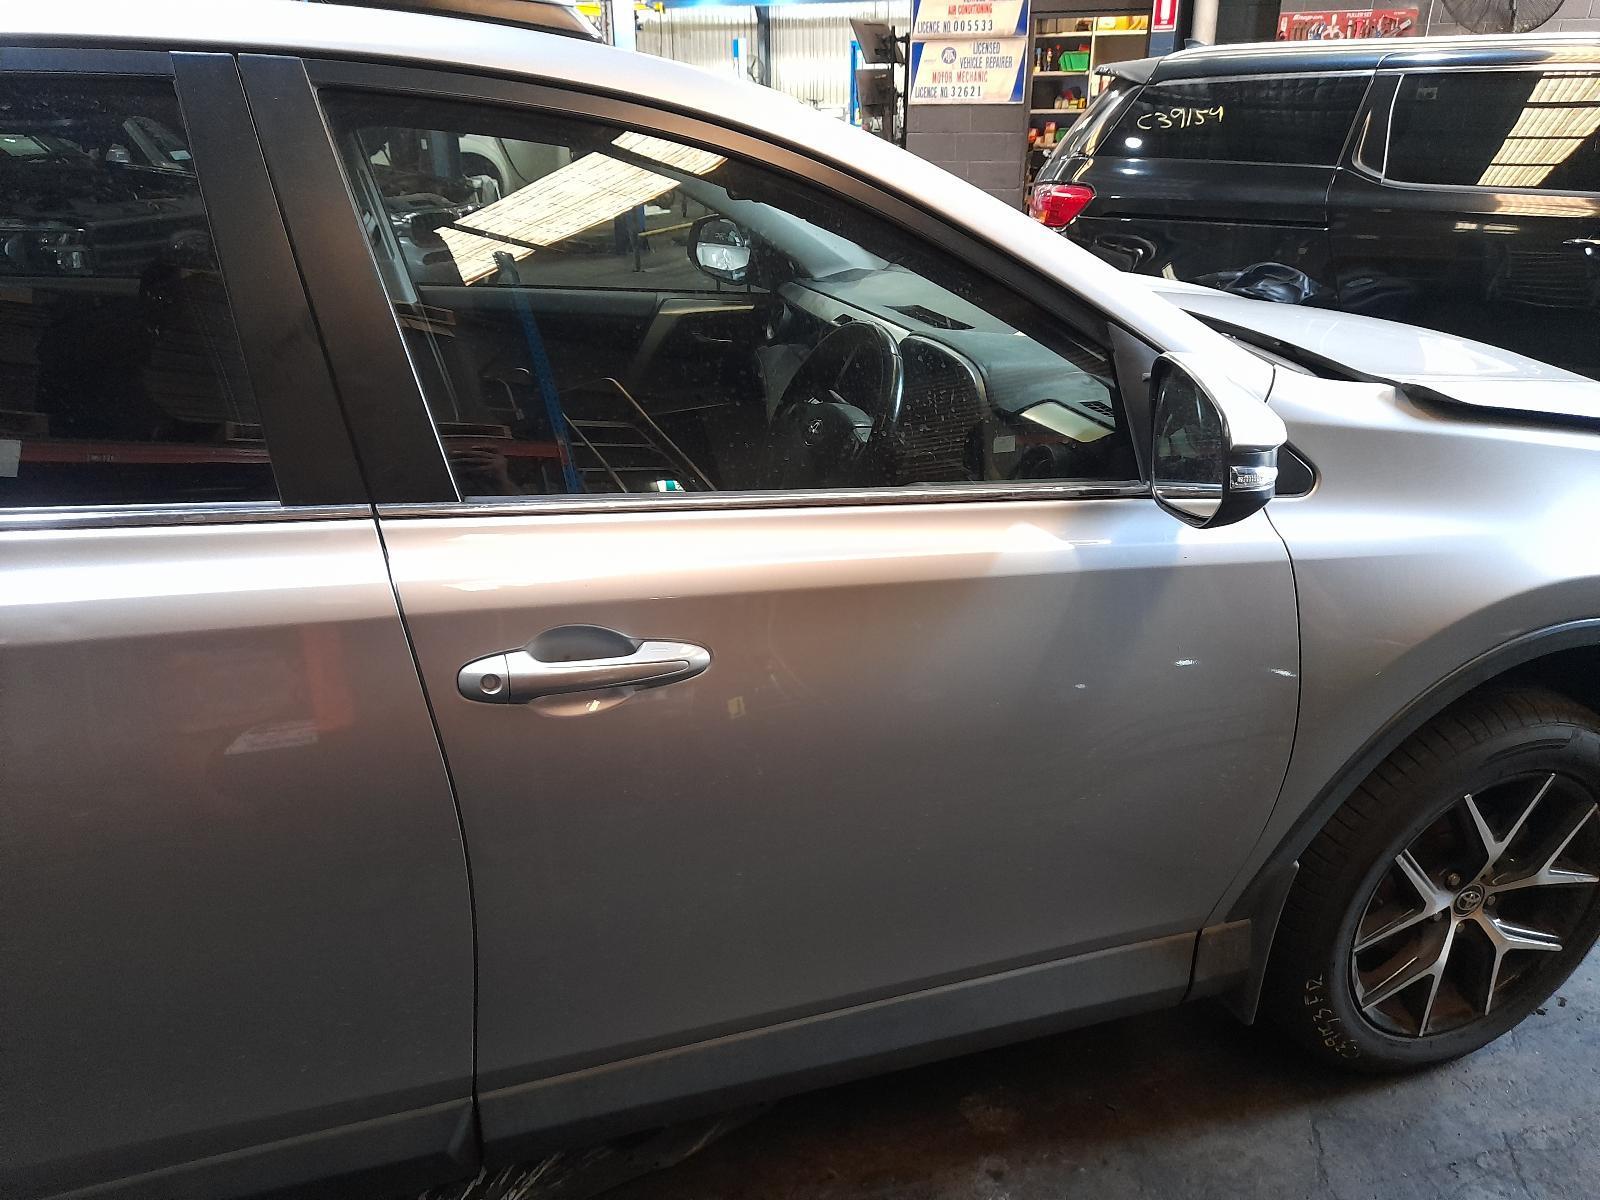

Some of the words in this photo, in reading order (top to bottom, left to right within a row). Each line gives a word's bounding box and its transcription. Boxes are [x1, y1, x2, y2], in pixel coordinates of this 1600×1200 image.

[958, 3, 993, 15] CONDITIONING
[917, 20, 940, 33] LICENCE
[953, 20, 993, 32] 005533
[973, 42, 1001, 55] LICENSED
[960, 57, 983, 69] VEHICLE
[985, 56, 1013, 69] REPAIRER
[932, 71, 953, 84] MOTOR
[956, 71, 988, 83] MECHANIC
[915, 87, 938, 98] LICENCE
[950, 86, 982, 98] 32621
[1136, 105, 1224, 130] C39154
